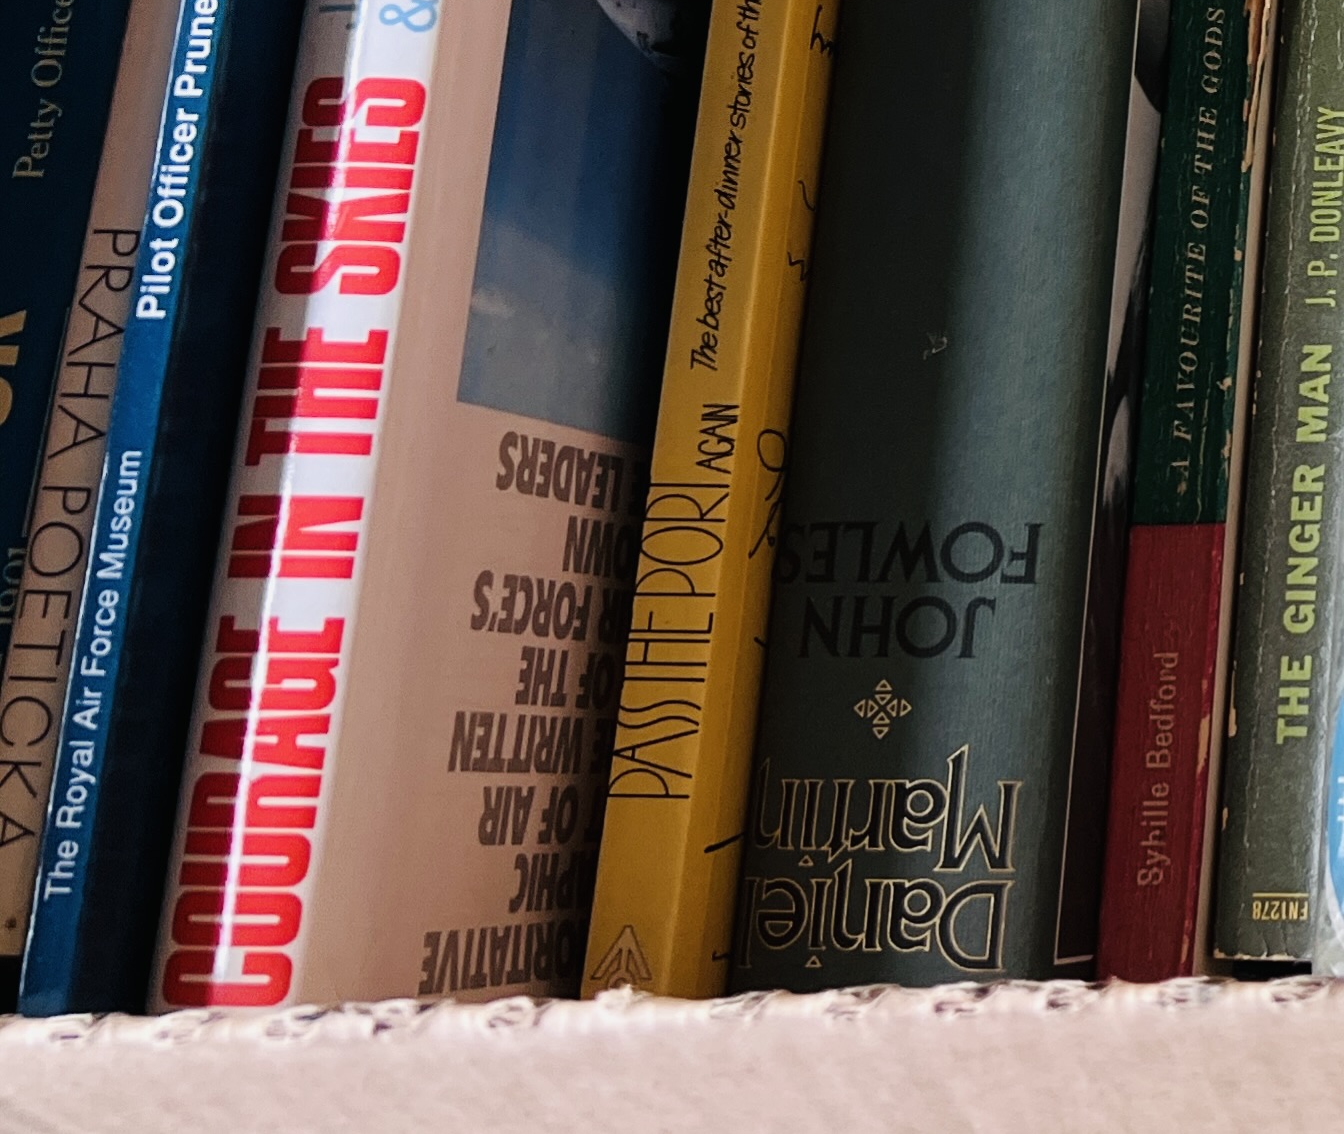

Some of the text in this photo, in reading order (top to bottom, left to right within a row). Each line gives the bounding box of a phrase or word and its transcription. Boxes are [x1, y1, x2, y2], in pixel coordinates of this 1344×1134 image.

[13, 99, 62, 181] Petty
[153, 107, 200, 227] Officer
[136, 238, 180, 320] Pilot
[1170, 7, 1226, 479] A FAVOURITE OF THE GODS
[48, 228, 142, 460] PRAHA
[1296, 344, 1333, 443] MAN
[496, 430, 624, 510] LEADERS
[695, 403, 740, 474] AGAIN
[162, 76, 428, 1007] COURAGE IN THE SKIES
[774, 522, 1045, 585] FOWLES
[1283, 463, 1326, 635] GINGER
[471, 570, 592, 635] FORCE'S
[798, 596, 997, 659] JOHN
[44, 450, 142, 901] The Royal Air Force Museum
[515, 645, 569, 707] THE
[1147, 651, 1180, 768] Bedford
[1276, 655, 1313, 745] THE
[447, 711, 582, 773] WRITTEN
[478, 785, 535, 847] AIR
[538, 785, 578, 843] OF
[752, 744, 1023, 872] Martin
[744, 858, 1015, 971] Daniel
[1252, 900, 1309, 921] FN1278
